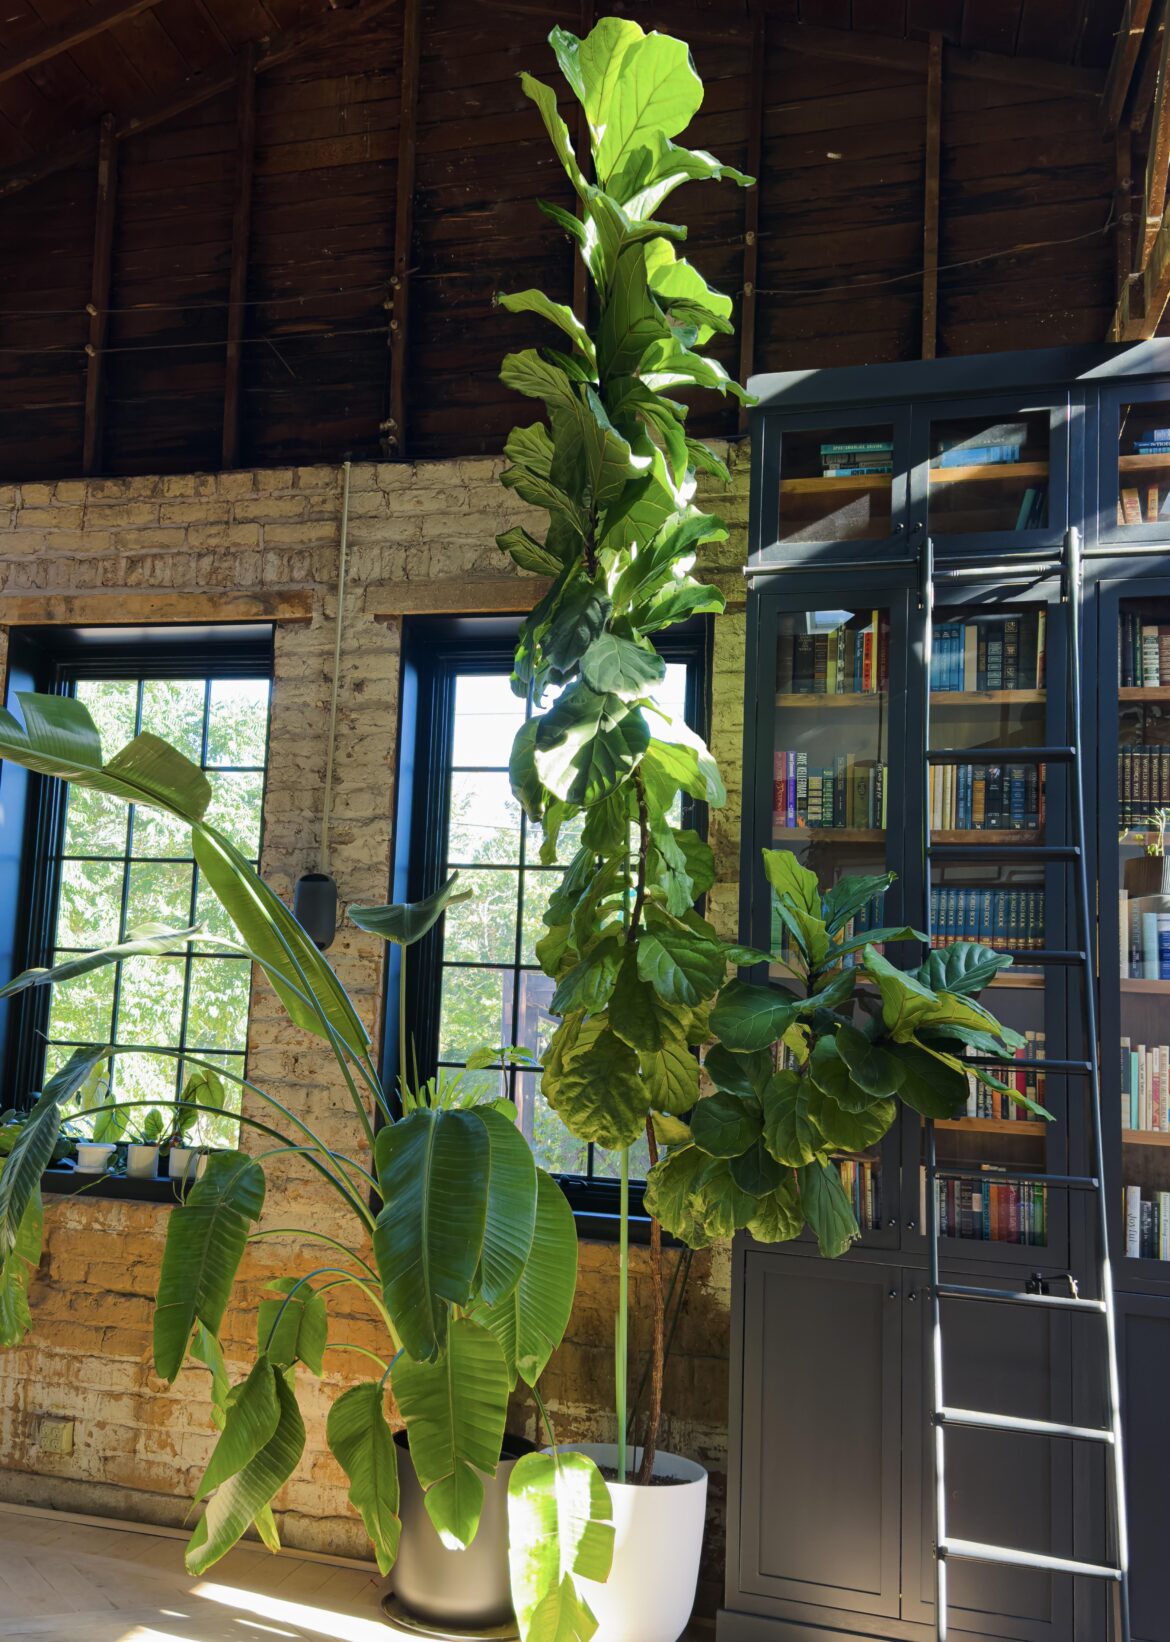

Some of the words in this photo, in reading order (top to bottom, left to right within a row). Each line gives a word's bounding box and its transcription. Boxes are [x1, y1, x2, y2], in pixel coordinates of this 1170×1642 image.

[797, 752, 808, 765] FAYE
[797, 766, 808, 798] KELLERMAN
[1127, 1213, 1137, 1242] Joyful
